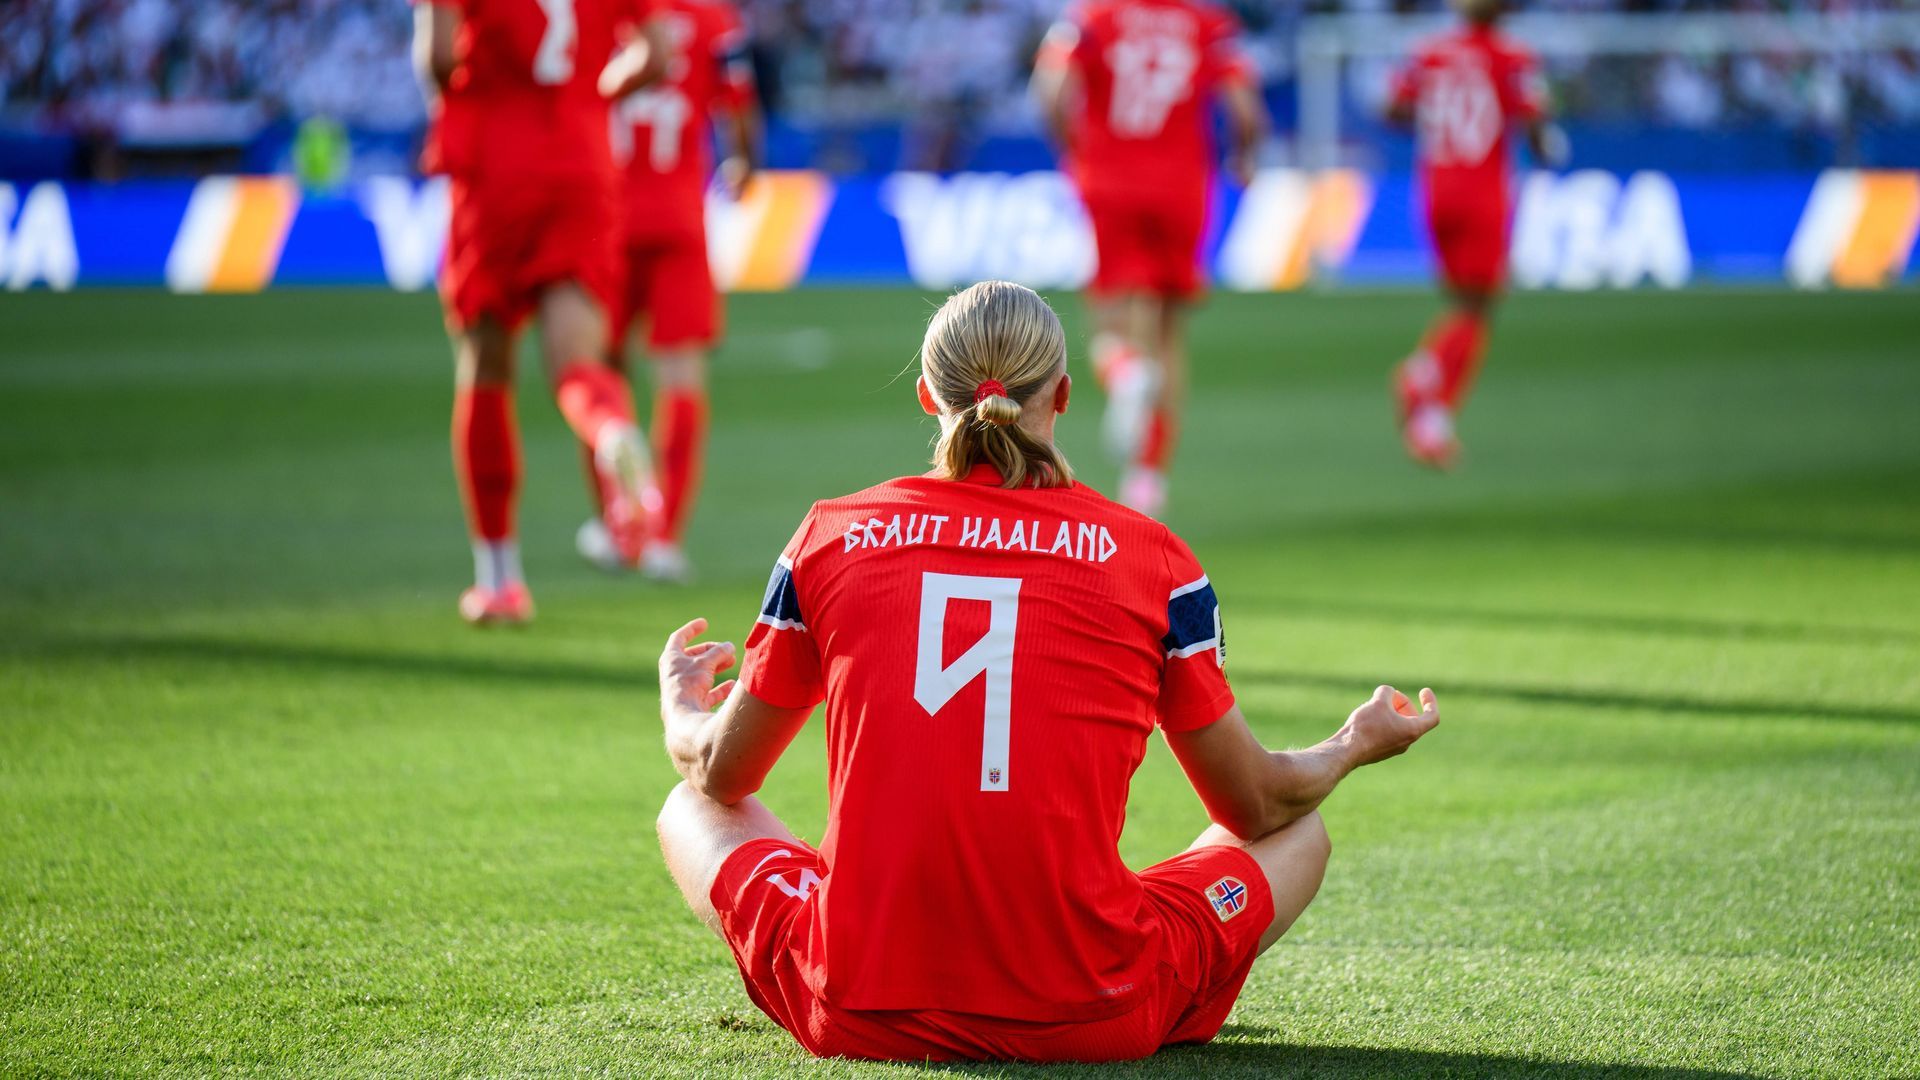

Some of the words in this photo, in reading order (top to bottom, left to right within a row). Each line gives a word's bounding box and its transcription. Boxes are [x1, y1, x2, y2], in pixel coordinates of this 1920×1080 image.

[843, 513, 949, 553] BRAUT
[958, 516, 1118, 563] HAALAND
[913, 571, 1023, 791] 9
